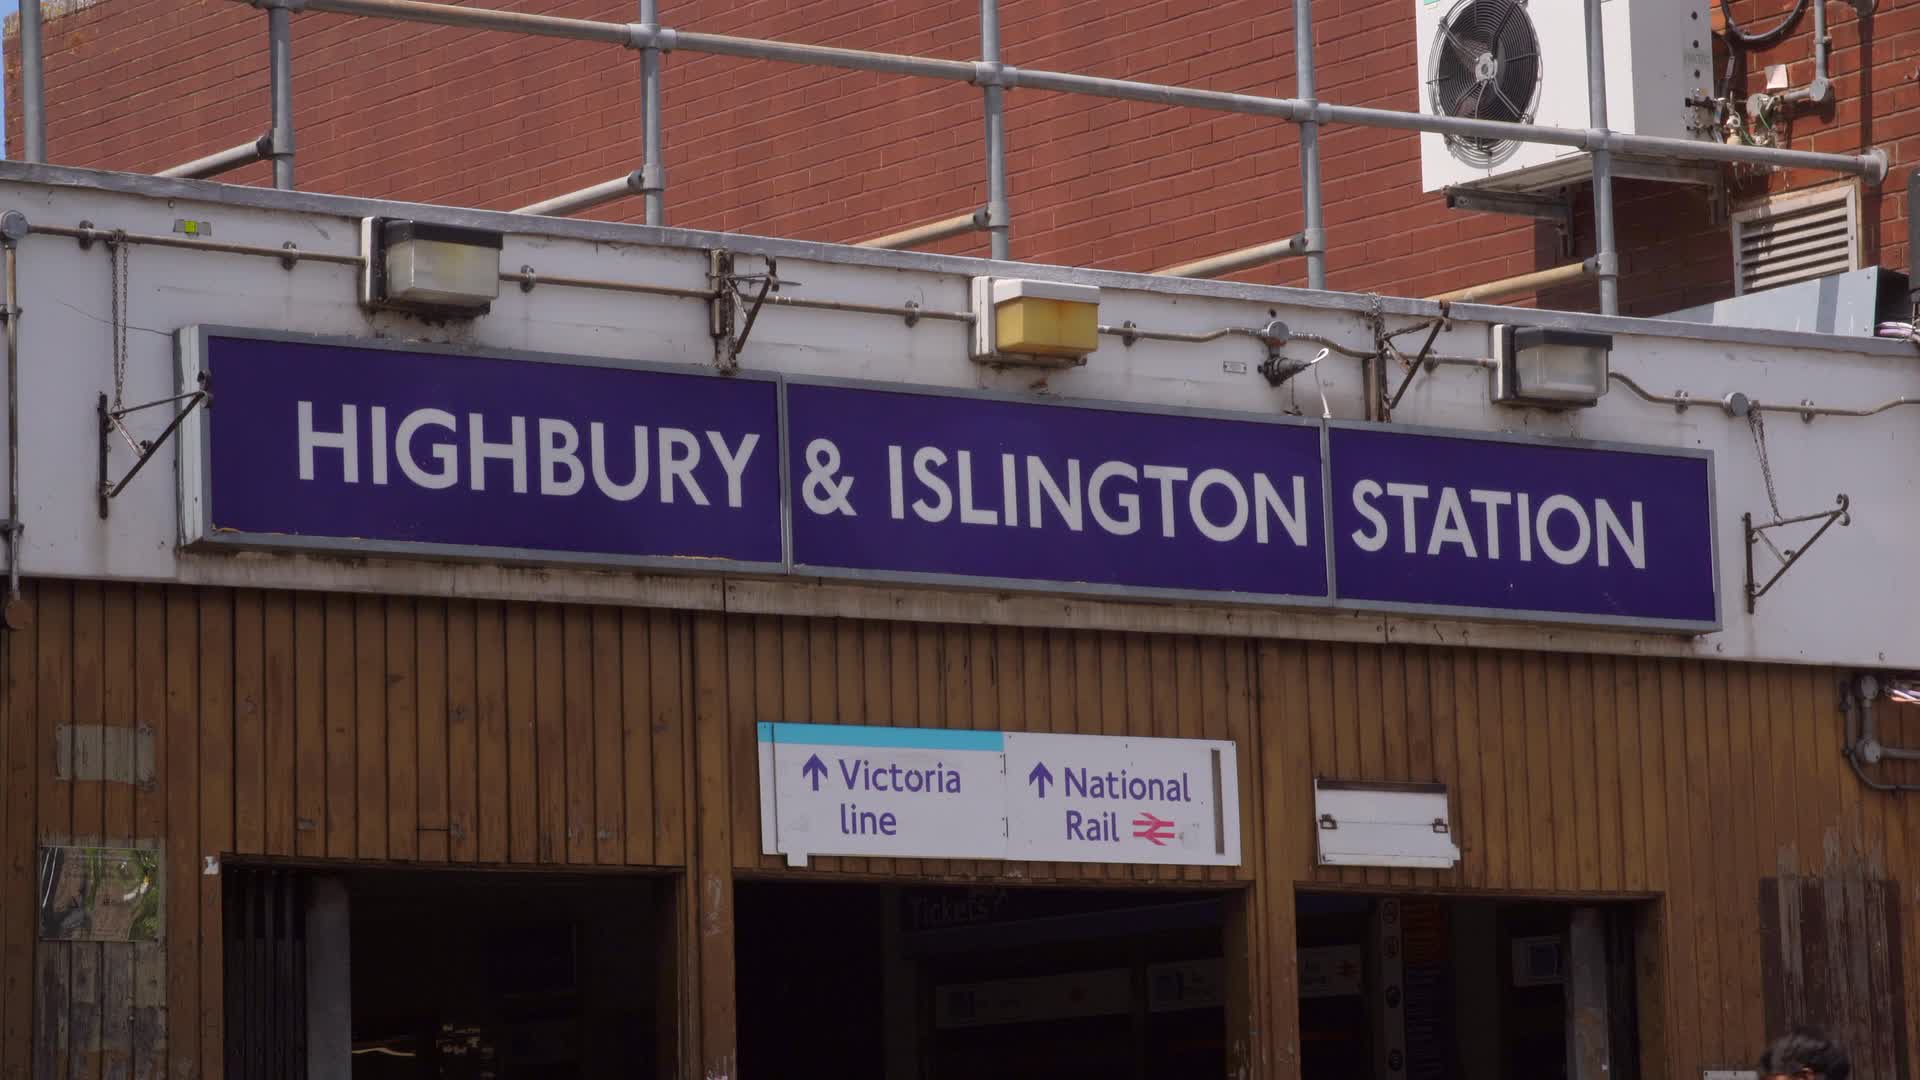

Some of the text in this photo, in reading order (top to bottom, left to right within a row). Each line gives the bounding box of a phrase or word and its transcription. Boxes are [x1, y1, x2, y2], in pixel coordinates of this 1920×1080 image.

[297, 400, 1647, 570] HIGHBURY & ISLINGTON STATION
[839, 759, 962, 794] Victoria
[1064, 767, 1192, 803] National
[841, 803, 897, 836] line
[1066, 810, 1120, 842] Rail
